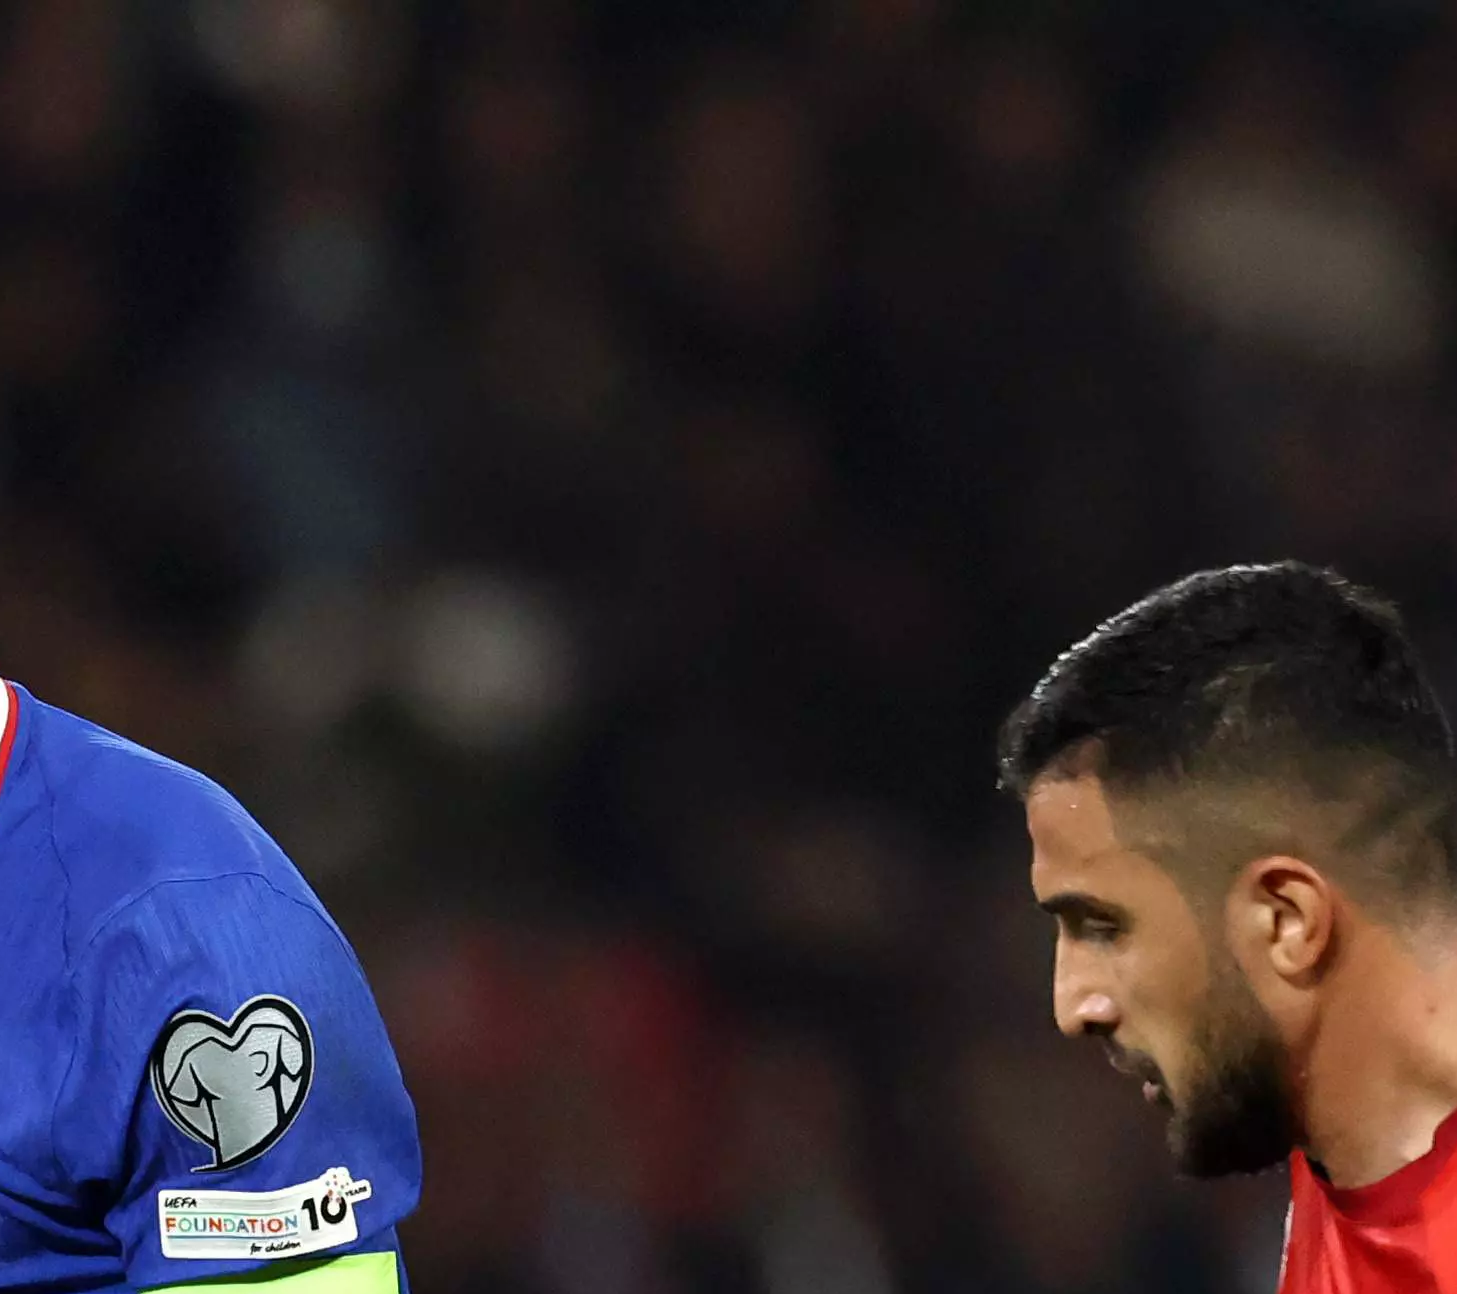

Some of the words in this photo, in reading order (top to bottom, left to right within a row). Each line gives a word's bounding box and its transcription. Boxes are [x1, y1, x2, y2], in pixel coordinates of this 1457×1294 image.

[164, 1197, 198, 1209] UEFA
[301, 1194, 347, 1231] 10
[165, 1214, 298, 1233] FOUNDATION
